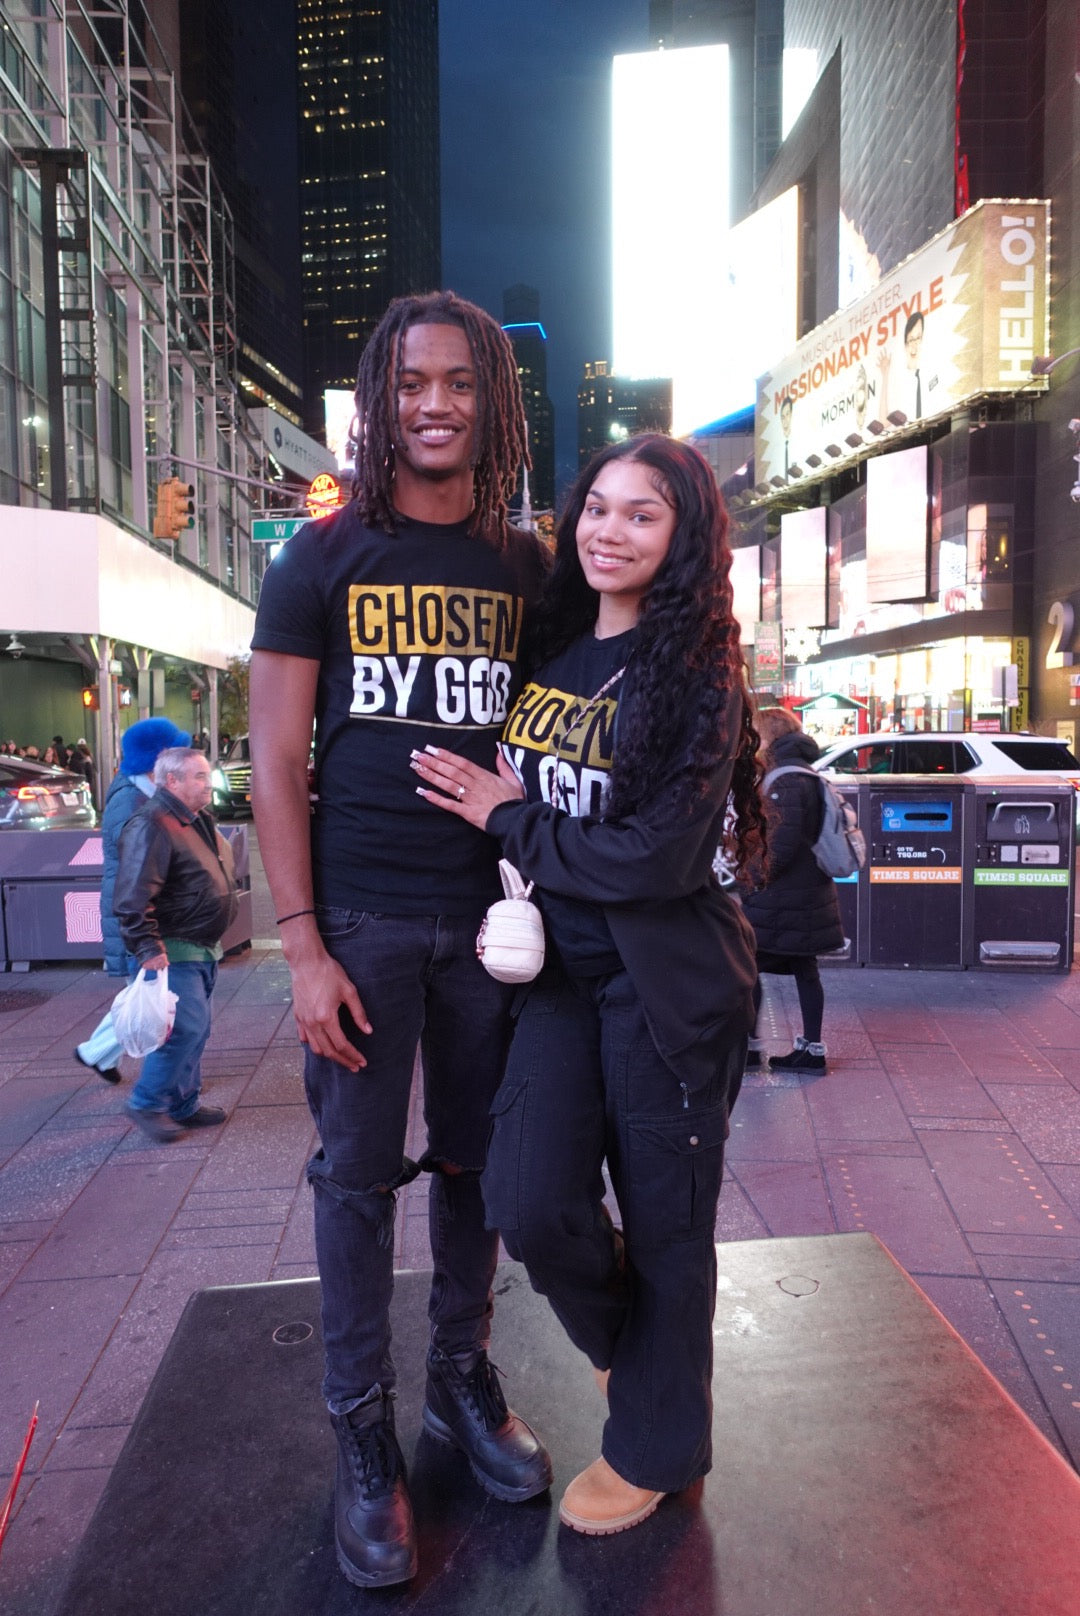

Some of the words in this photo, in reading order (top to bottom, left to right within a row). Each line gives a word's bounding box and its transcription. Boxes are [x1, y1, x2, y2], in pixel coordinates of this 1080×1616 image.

[999, 215, 1036, 382] HELLO!
[773, 325, 873, 415] MISSIONARY
[800, 330, 845, 366] MUSICAL
[274, 523, 286, 537] W
[354, 584, 521, 661] CHOSEN
[1045, 601, 1075, 669] 2
[349, 656, 421, 717] BY
[434, 657, 512, 725] GOD
[873, 870, 911, 881] TIMES
[913, 870, 960, 881] SQUARE
[977, 872, 1016, 882] TIMES
[1018, 873, 1066, 883] SQUARE
